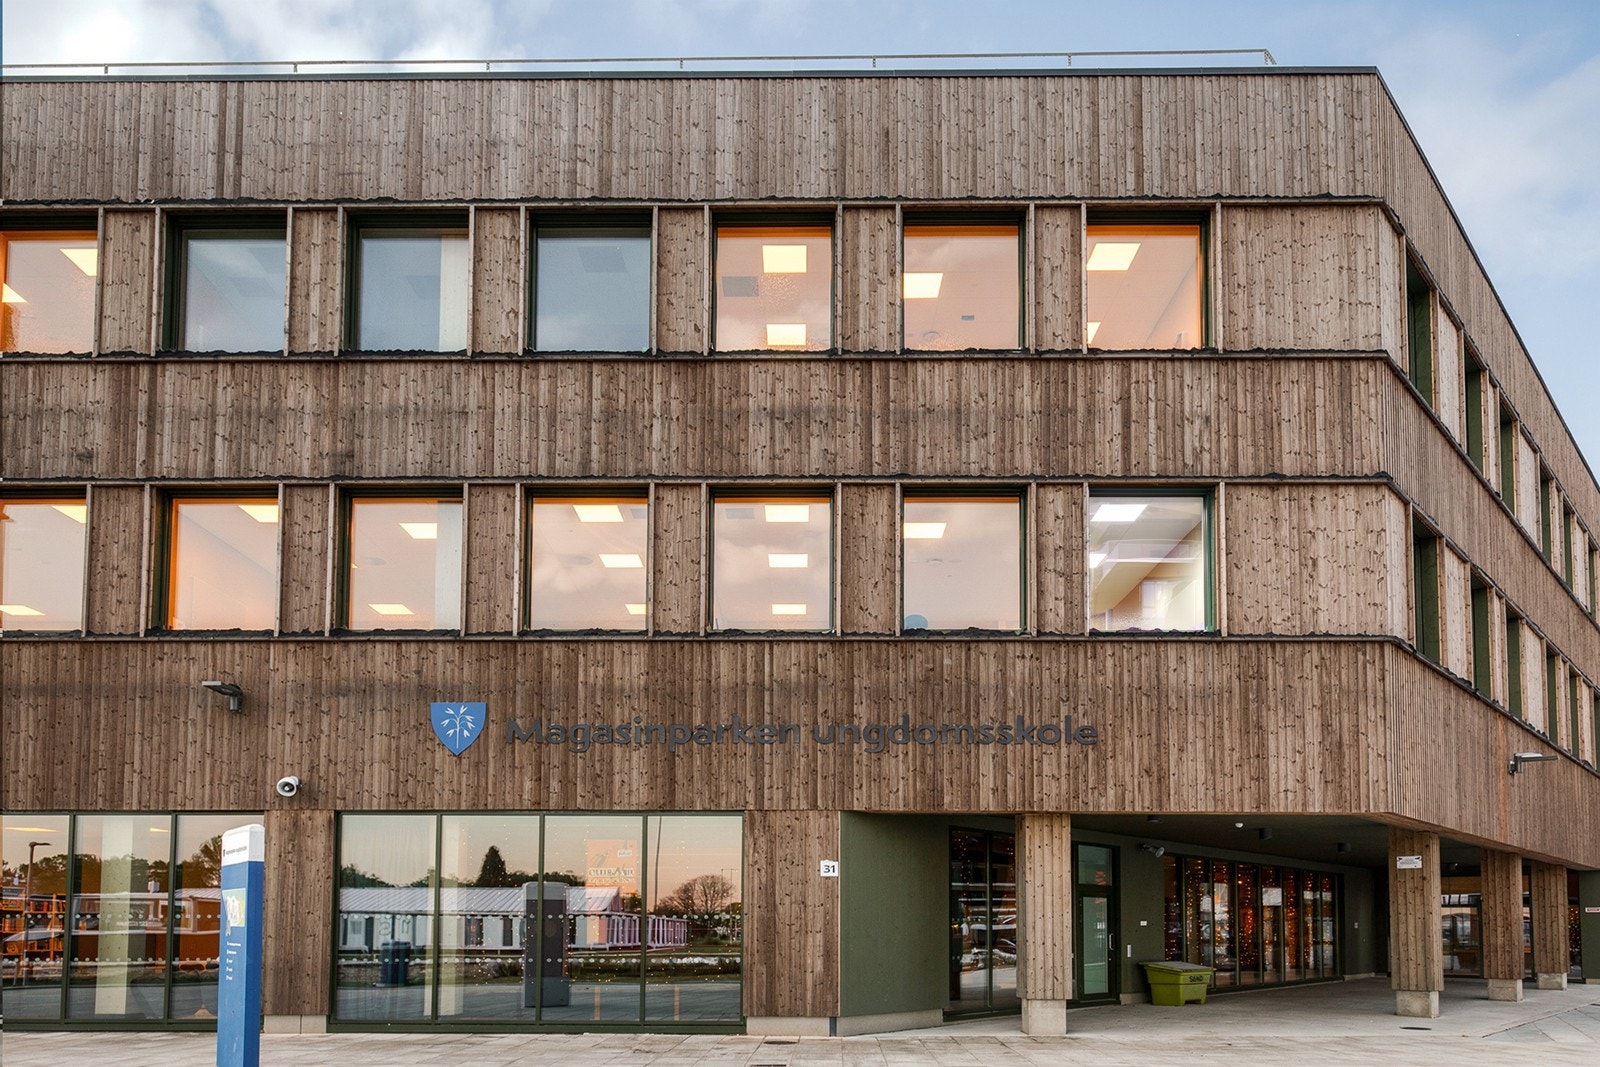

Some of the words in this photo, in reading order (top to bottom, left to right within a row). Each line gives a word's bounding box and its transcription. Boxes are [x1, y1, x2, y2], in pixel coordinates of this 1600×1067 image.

[505, 715, 800, 752] Magasinparken
[813, 714, 1098, 752] ungdomsskole
[823, 864, 836, 874] 31
[1189, 975, 1204, 983] SAND
